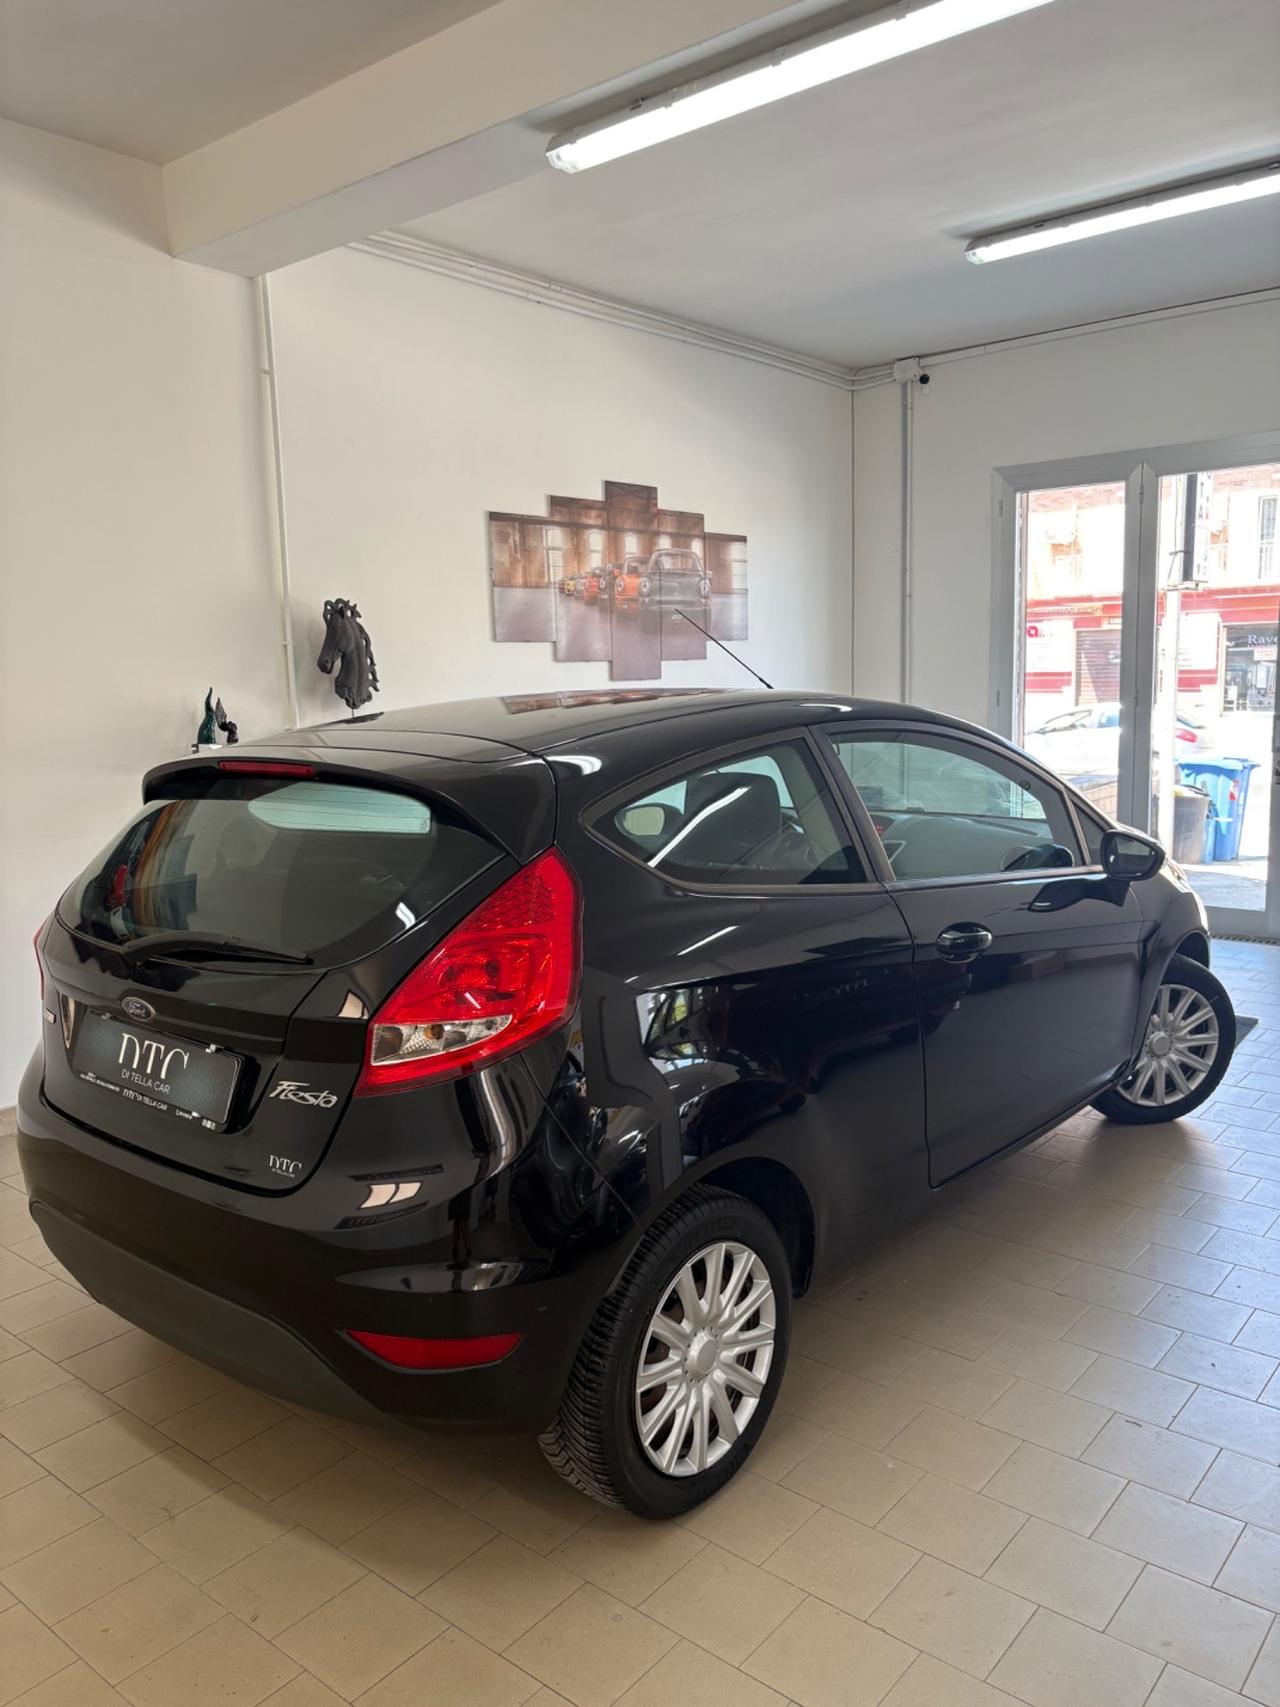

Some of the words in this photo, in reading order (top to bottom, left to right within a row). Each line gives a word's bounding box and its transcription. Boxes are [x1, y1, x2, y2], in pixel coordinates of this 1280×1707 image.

[128, 1001, 146, 1018] Ford
[121, 1068, 130, 1079] DI
[131, 1073, 153, 1089] TELLA
[153, 1081, 171, 1095] CAR
[269, 1080, 338, 1108] Fiesta
